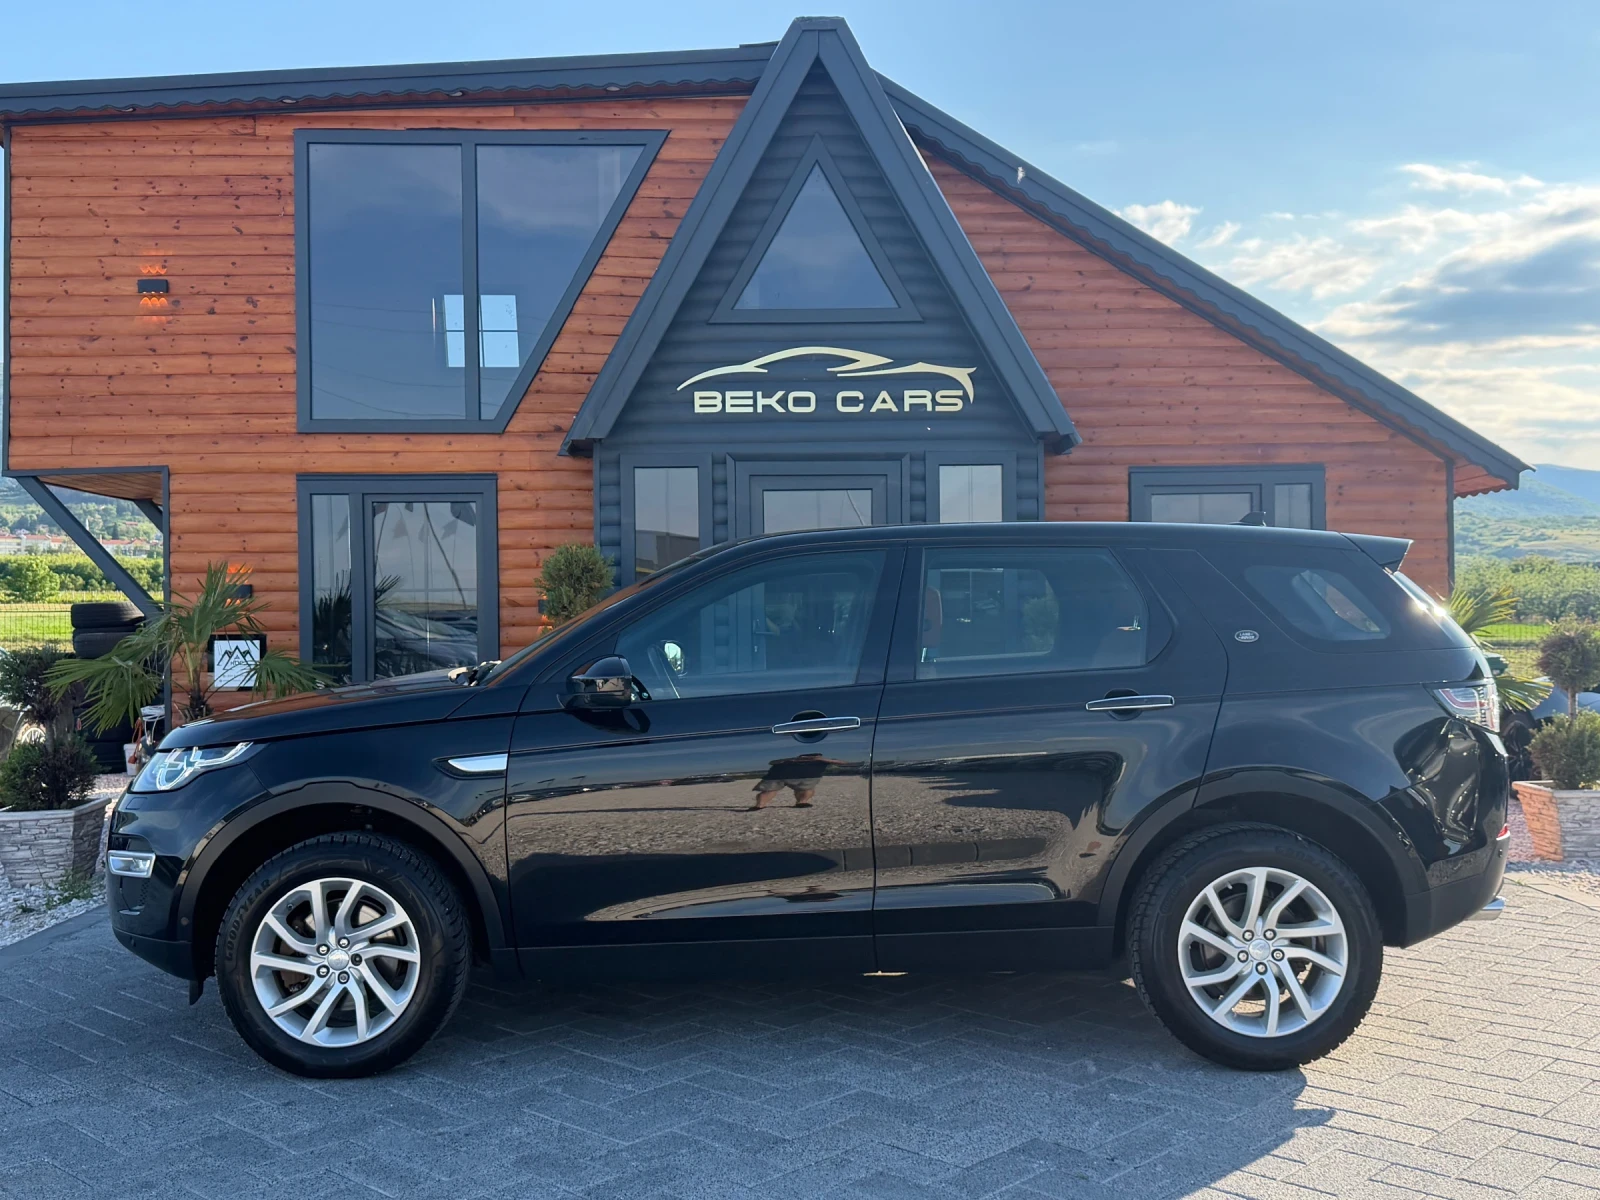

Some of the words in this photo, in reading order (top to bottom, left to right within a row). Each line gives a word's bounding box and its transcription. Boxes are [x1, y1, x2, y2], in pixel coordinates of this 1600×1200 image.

[693, 390, 816, 413] BEKO
[836, 389, 964, 413] CARS
[225, 879, 270, 961] GOODYEAR
